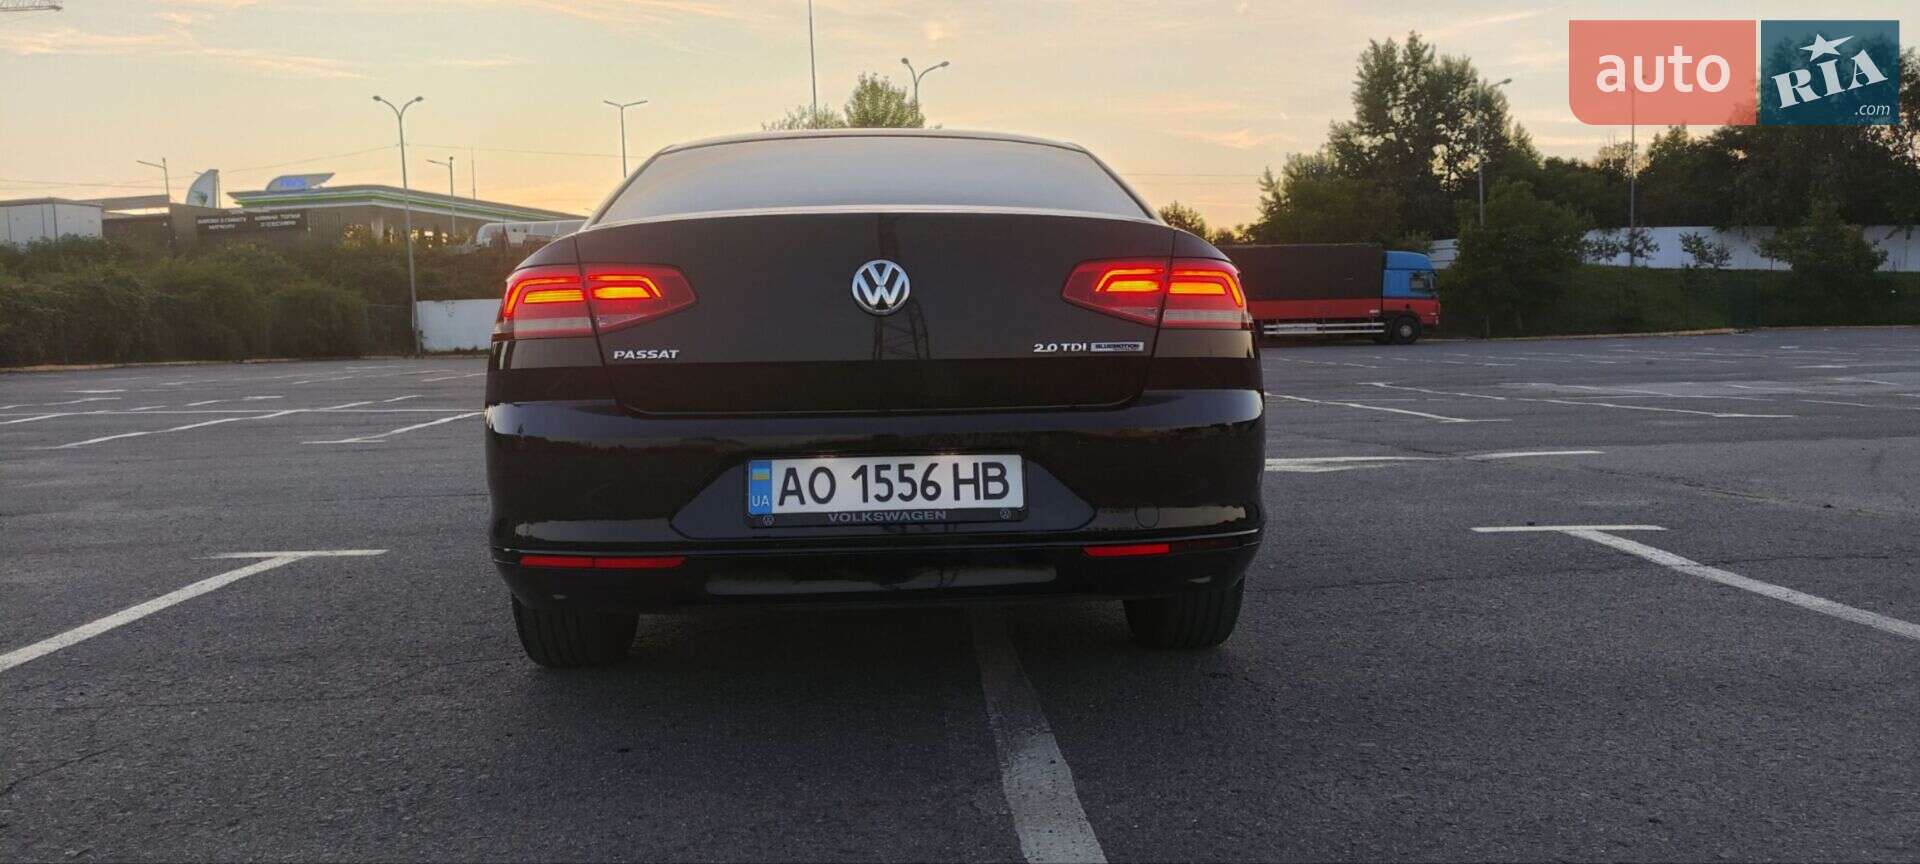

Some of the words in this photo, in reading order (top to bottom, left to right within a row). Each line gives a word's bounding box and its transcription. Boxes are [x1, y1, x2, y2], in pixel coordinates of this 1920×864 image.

[1033, 343, 1058, 353] 2.0
[1060, 342, 1087, 352] TDI
[613, 349, 679, 359] PASSAT
[778, 466, 837, 506] AO
[851, 462, 942, 503] 1556
[952, 462, 1010, 501] HB
[751, 495, 770, 507] UA
[827, 510, 947, 523] VOLKSWAGEN
